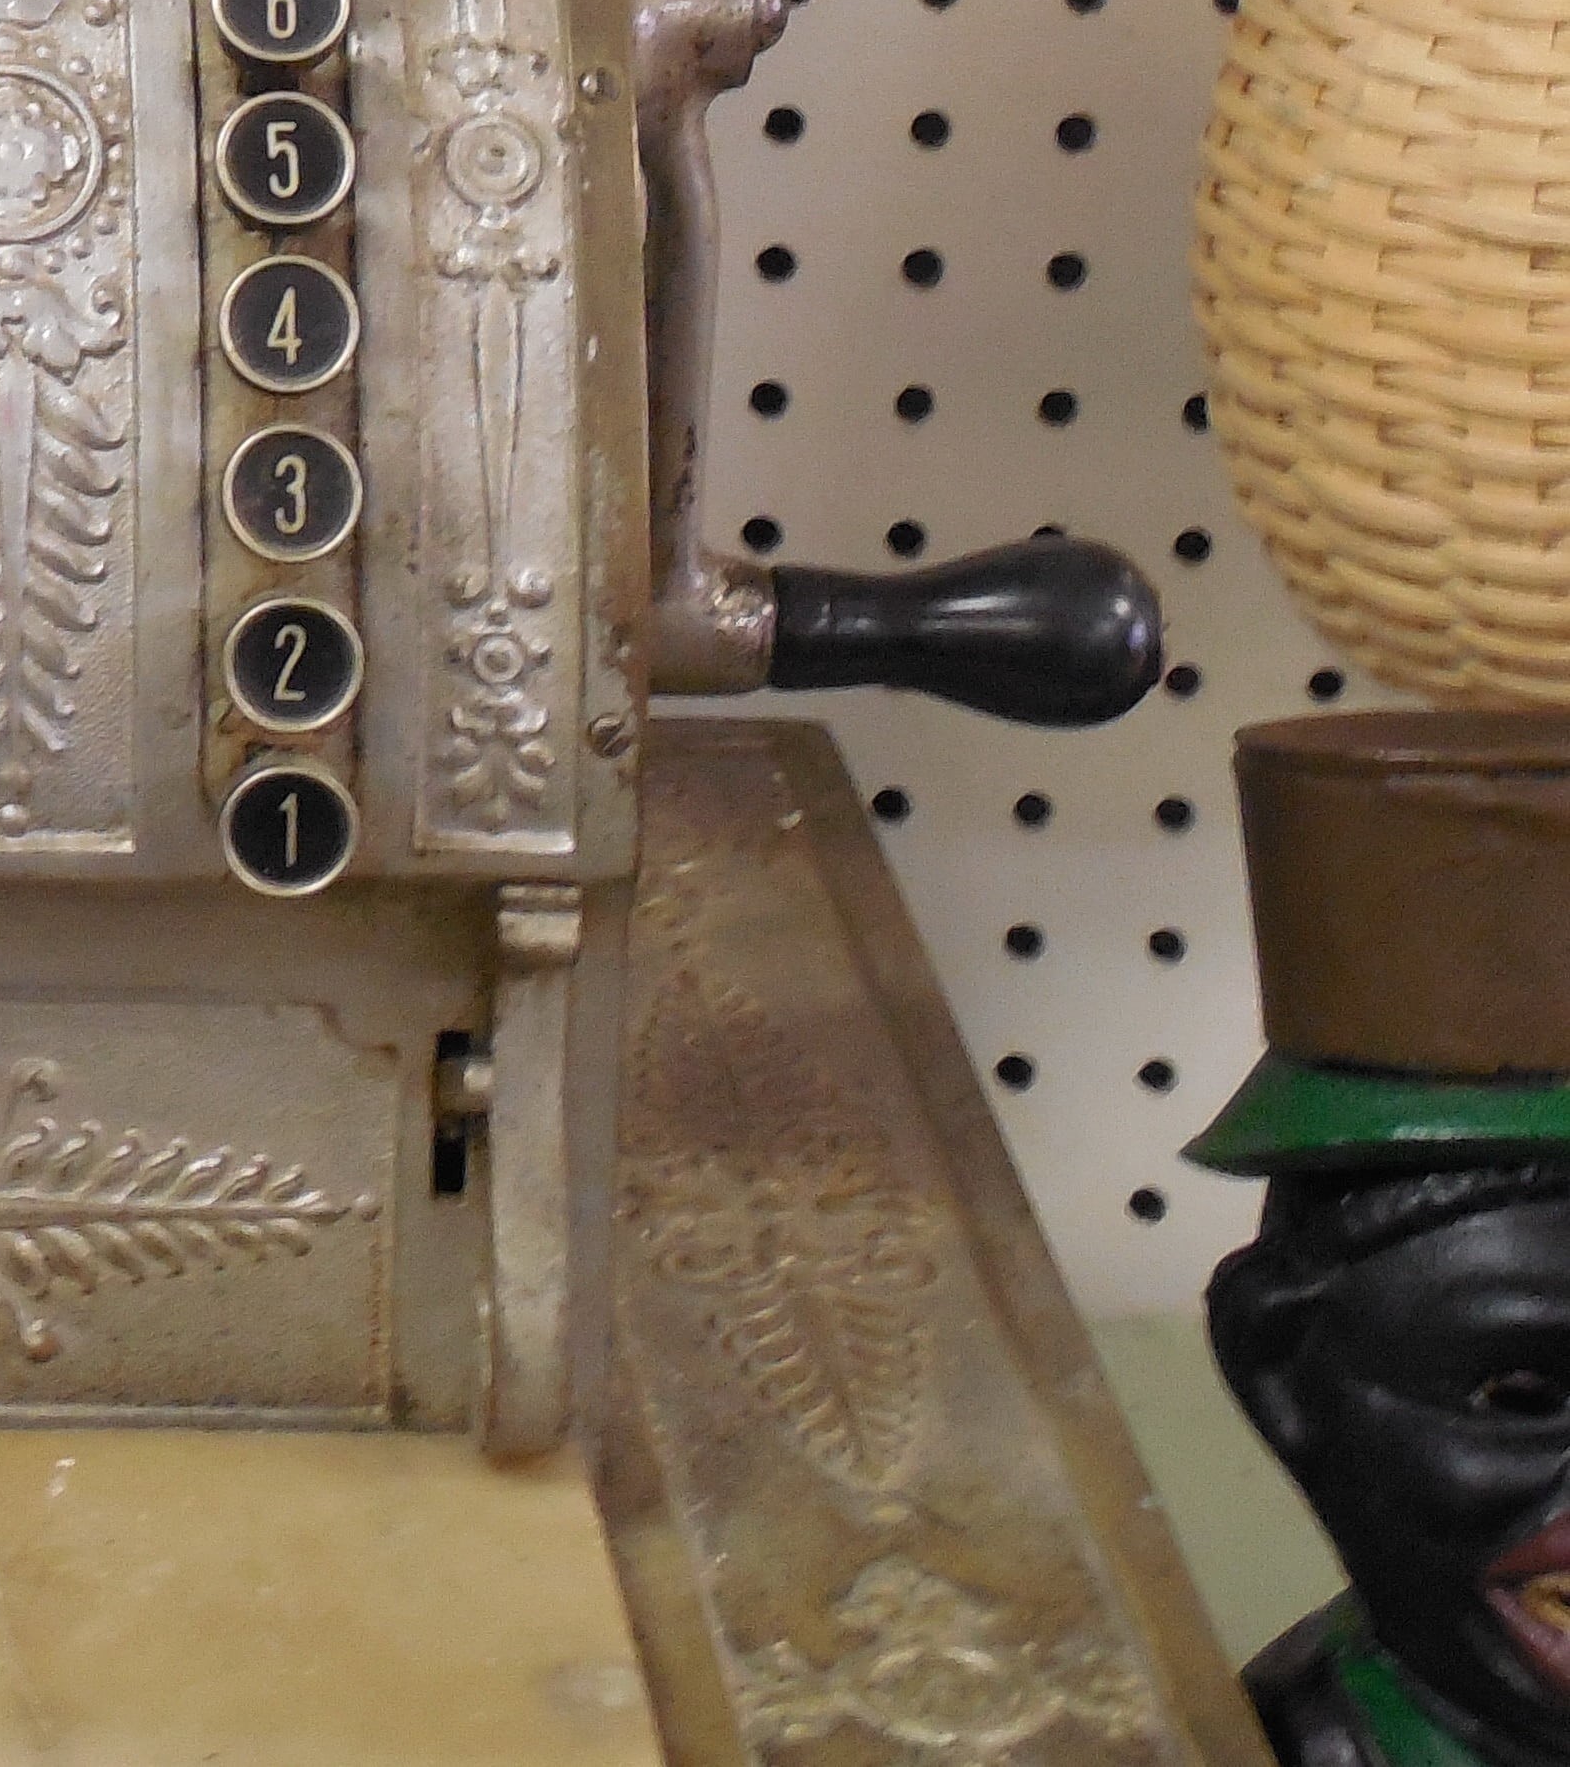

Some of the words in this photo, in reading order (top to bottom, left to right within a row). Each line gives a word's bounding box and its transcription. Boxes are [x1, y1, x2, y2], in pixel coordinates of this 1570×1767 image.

[265, 120, 300, 199] 5
[267, 285, 303, 366] 4
[274, 454, 308, 534] 3
[273, 624, 307, 702] 2
[277, 791, 300, 869] 1
